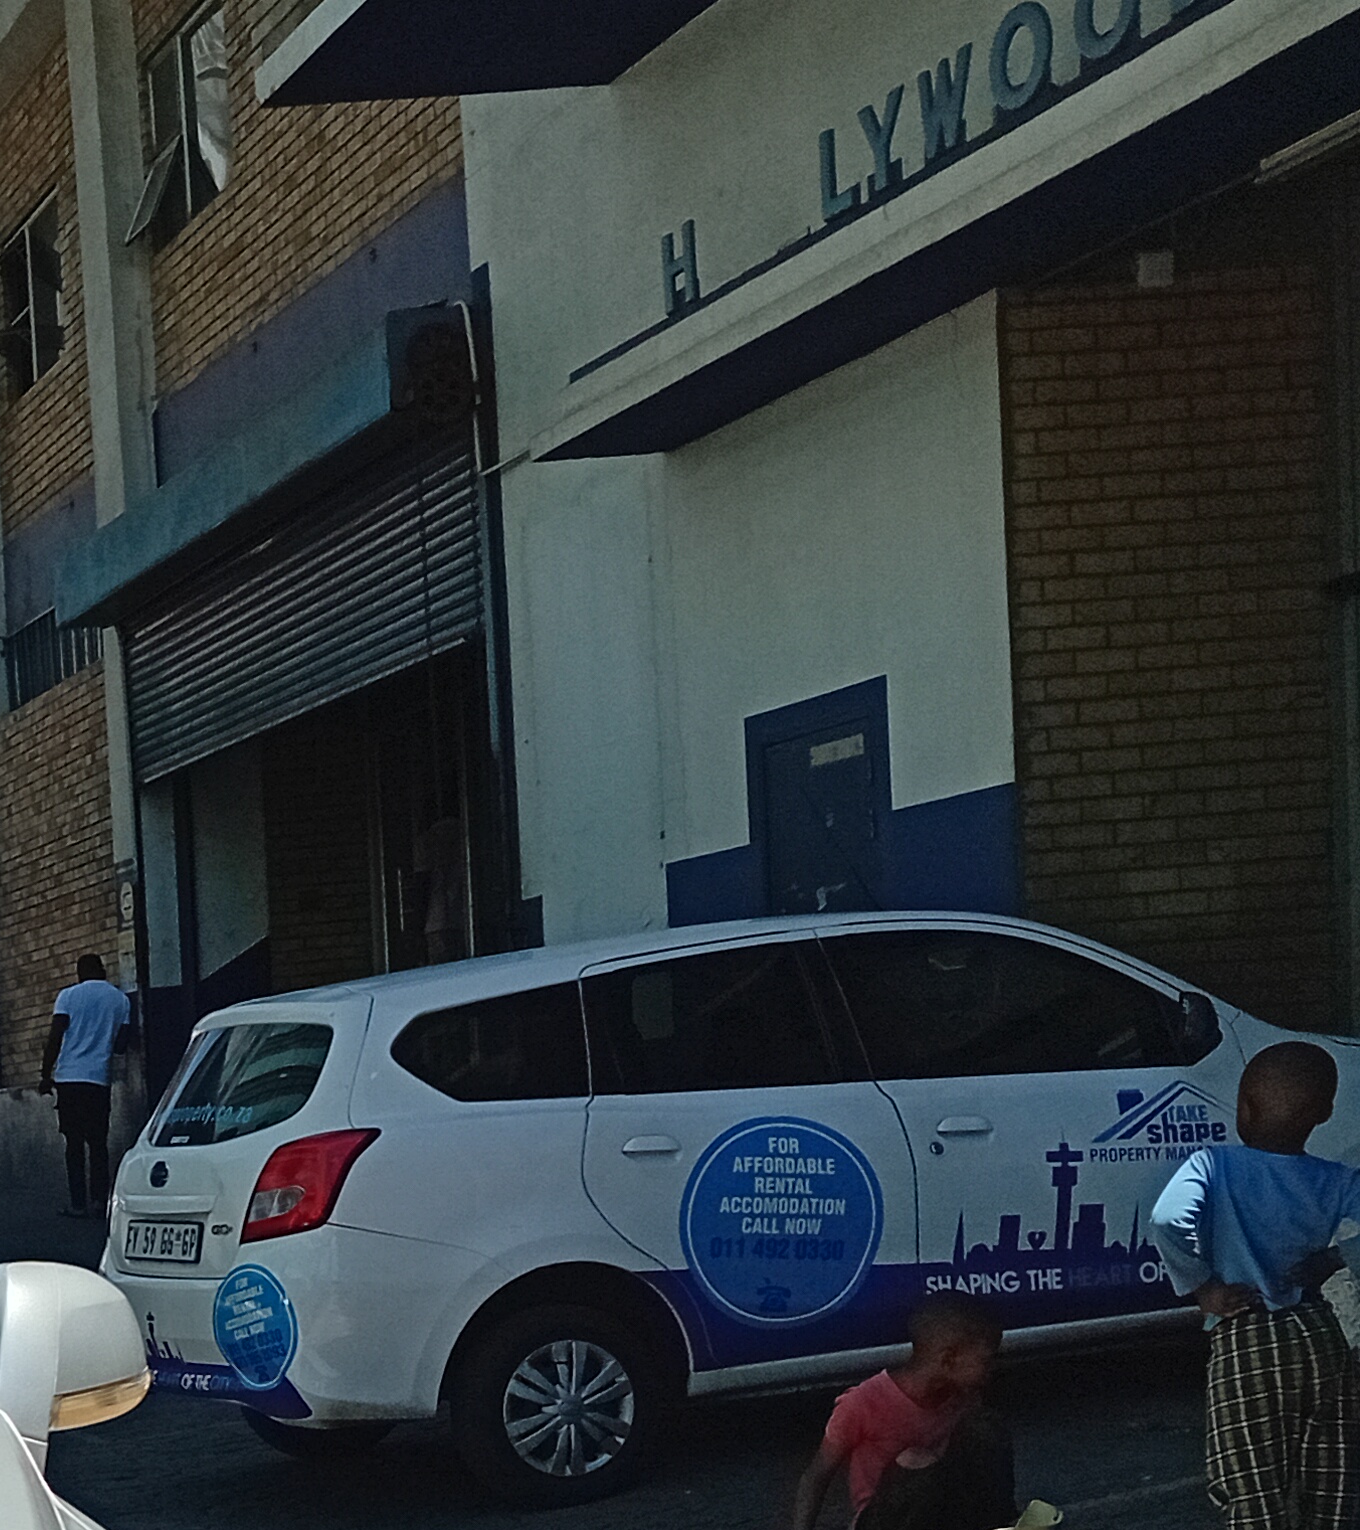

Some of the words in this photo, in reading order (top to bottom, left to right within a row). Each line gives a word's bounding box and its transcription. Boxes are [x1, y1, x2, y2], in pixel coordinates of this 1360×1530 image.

[1167, 1104, 1208, 1122] TAKE
[1147, 1111, 1226, 1144] shape
[768, 1137, 799, 1154] FOR
[1089, 1147, 1161, 1163] PROPERTY
[733, 1156, 836, 1175] AFFORDABLE
[754, 1177, 813, 1194] RENTAL
[720, 1196, 846, 1215] ACCOMODATION
[741, 1217, 780, 1235] CALL
[785, 1217, 822, 1235] NOW
[710, 1237, 746, 1260] 011
[752, 1237, 791, 1260] 492
[794, 1238, 846, 1261] 0330
[926, 1269, 1021, 1296] SHAPING
[1026, 1268, 1063, 1291] THE
